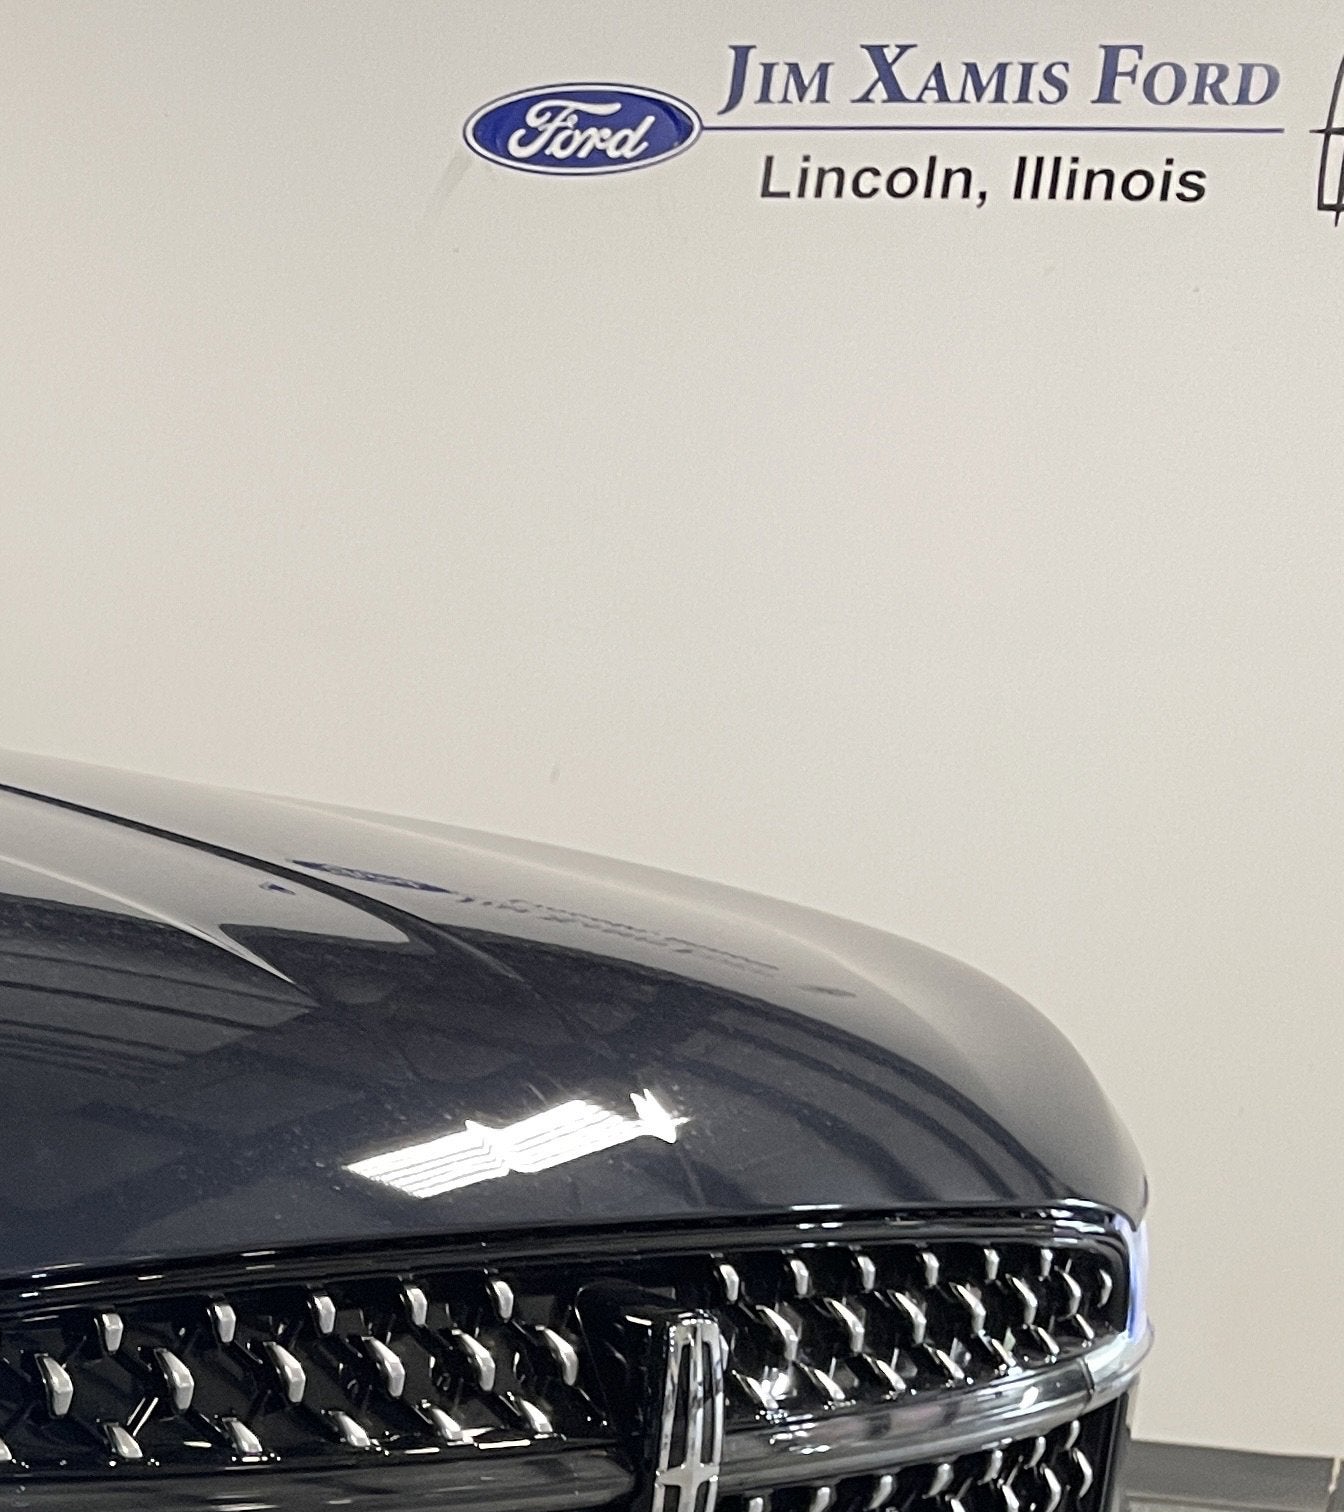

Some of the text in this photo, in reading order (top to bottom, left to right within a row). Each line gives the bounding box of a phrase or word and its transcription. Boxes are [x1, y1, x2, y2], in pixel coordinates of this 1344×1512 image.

[717, 44, 1283, 116] JIM XAMIS FORD
[507, 98, 655, 162] Ford
[760, 155, 1209, 209] Lincoln, Illinois
